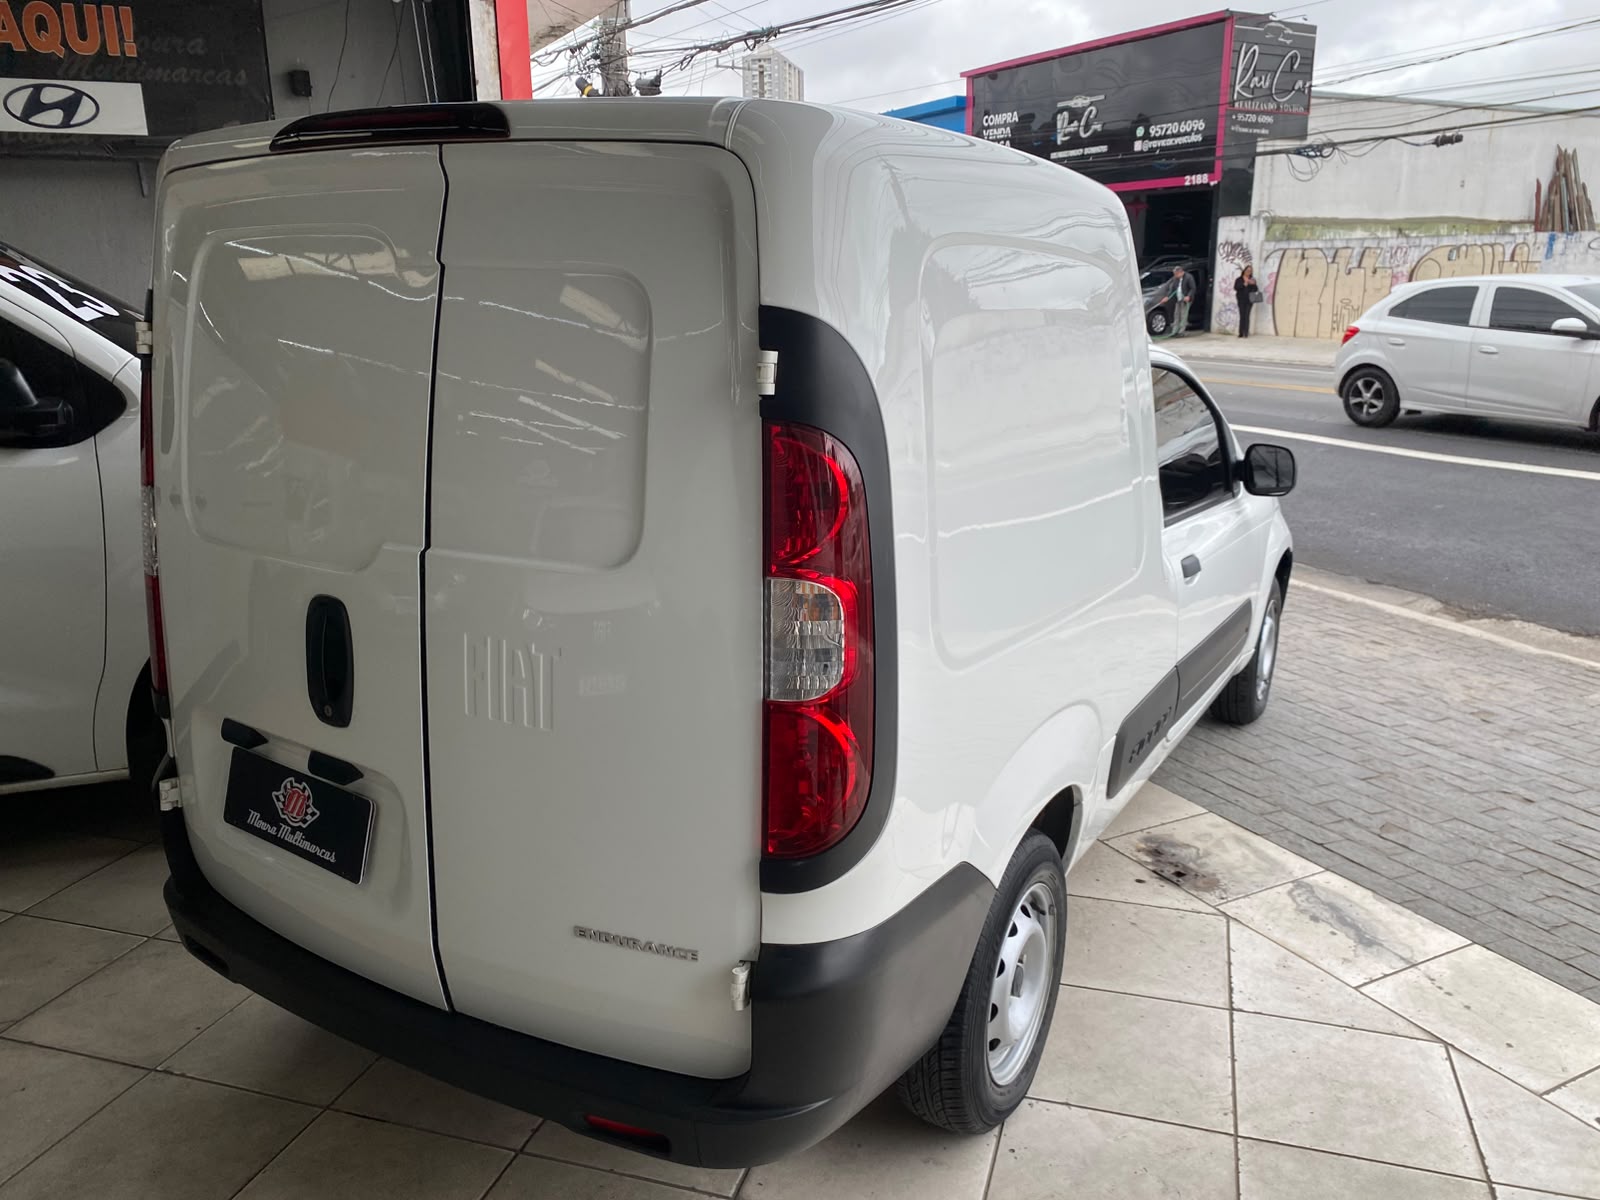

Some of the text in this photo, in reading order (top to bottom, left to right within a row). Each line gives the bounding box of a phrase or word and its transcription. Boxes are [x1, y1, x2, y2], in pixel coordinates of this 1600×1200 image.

[0, 1, 137, 58] AQUI!
[983, 111, 1019, 127] COMPRA
[1149, 119, 1205, 137] 95720 6096
[983, 126, 1012, 140] VENDA
[1184, 173, 1209, 186] 2188
[462, 631, 562, 732] FIAT
[246, 808, 337, 863] Moura Multimarcas
[573, 925, 699, 962] ENDURANCE
